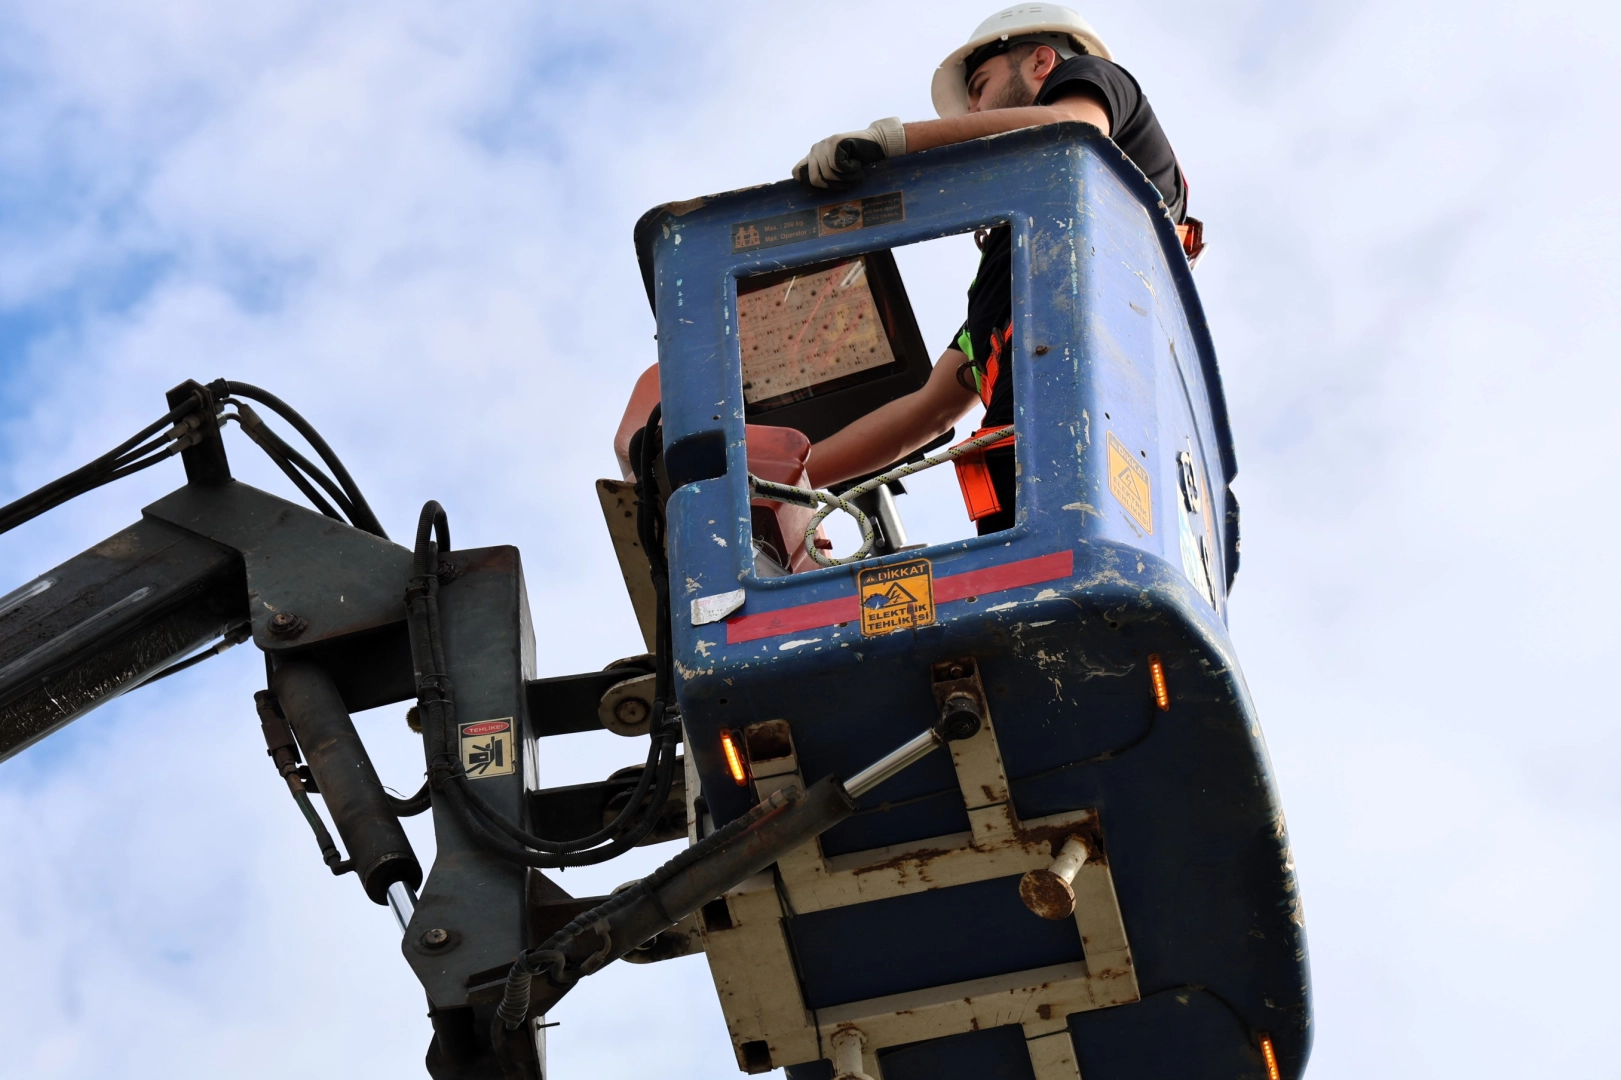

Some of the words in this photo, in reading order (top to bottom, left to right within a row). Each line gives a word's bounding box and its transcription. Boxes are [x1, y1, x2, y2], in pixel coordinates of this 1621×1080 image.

[780, 229, 807, 240] Operator
[877, 564, 926, 581] DİKKAT
[868, 603, 927, 621] ELEKTİK
